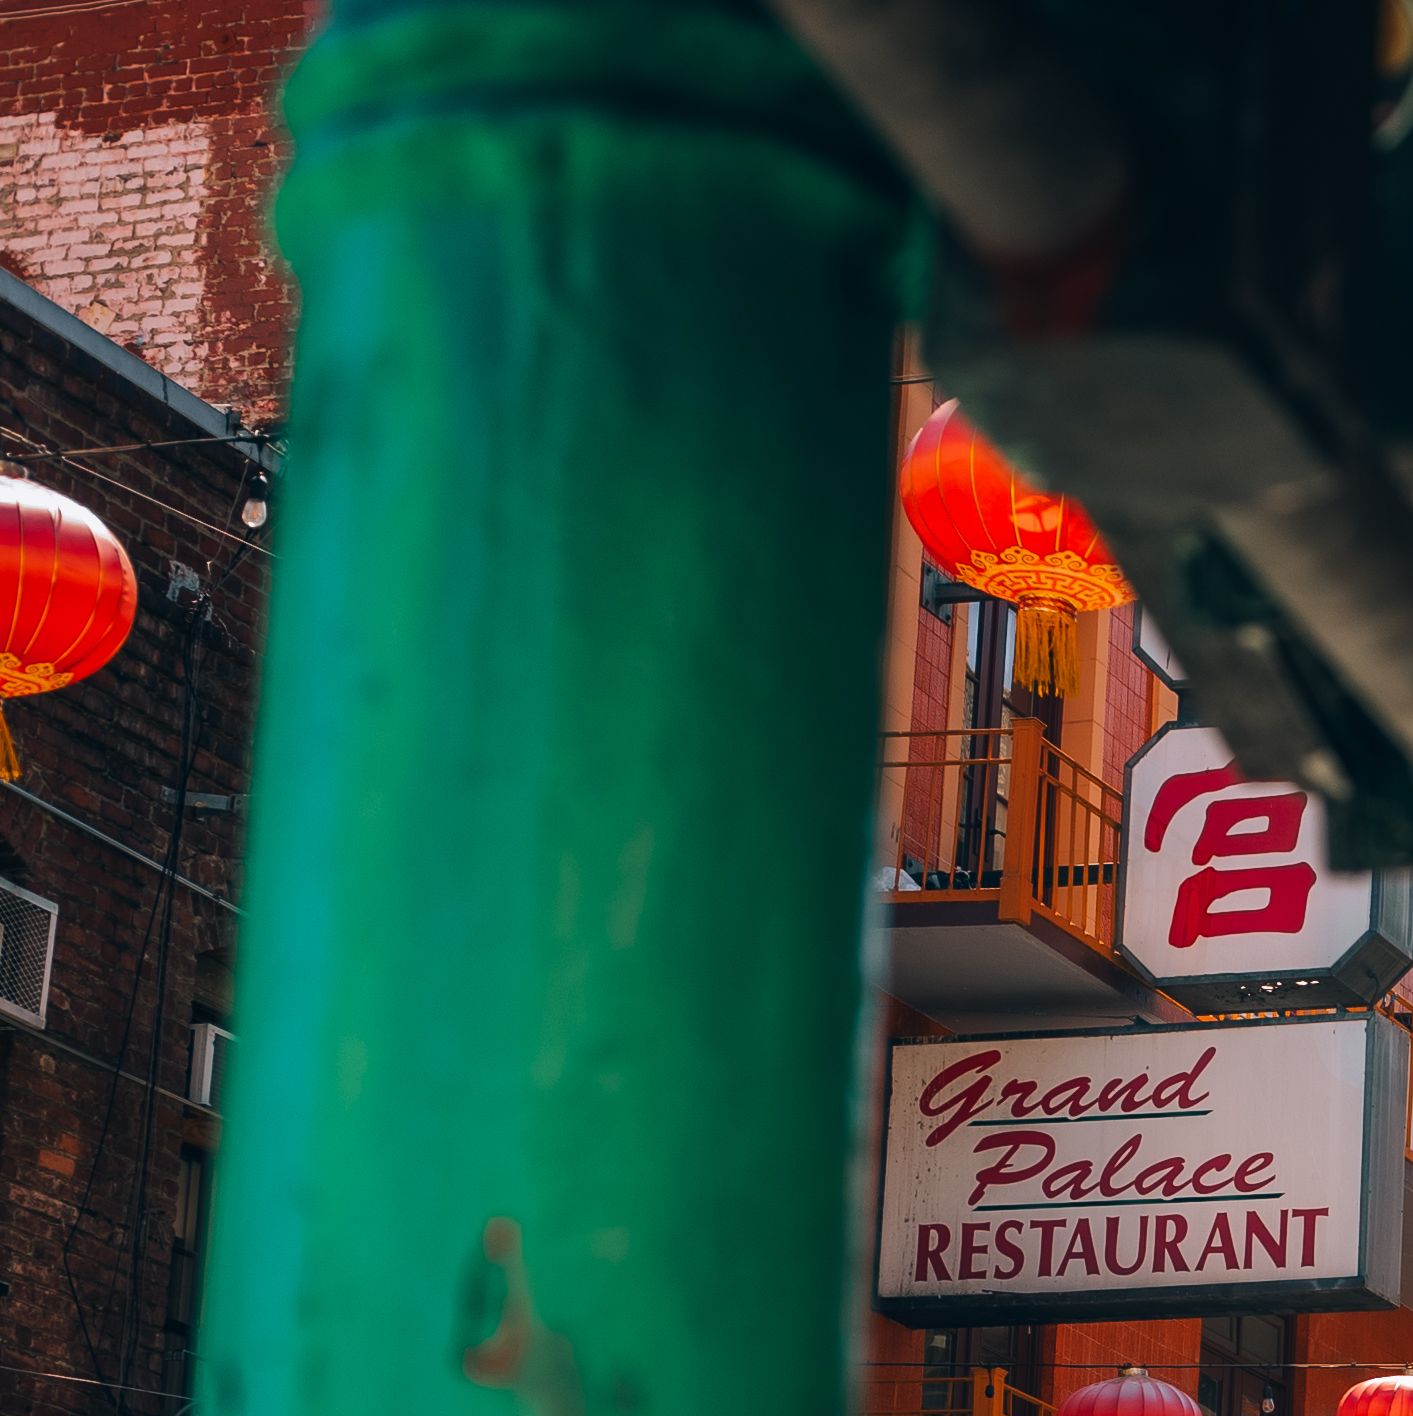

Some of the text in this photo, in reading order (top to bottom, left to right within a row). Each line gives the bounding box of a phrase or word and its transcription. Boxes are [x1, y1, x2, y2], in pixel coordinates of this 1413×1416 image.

[919, 1046, 1216, 1147] Grand
[969, 1130, 1276, 1206] Palace
[914, 1207, 1329, 1283] RESTAURANT
